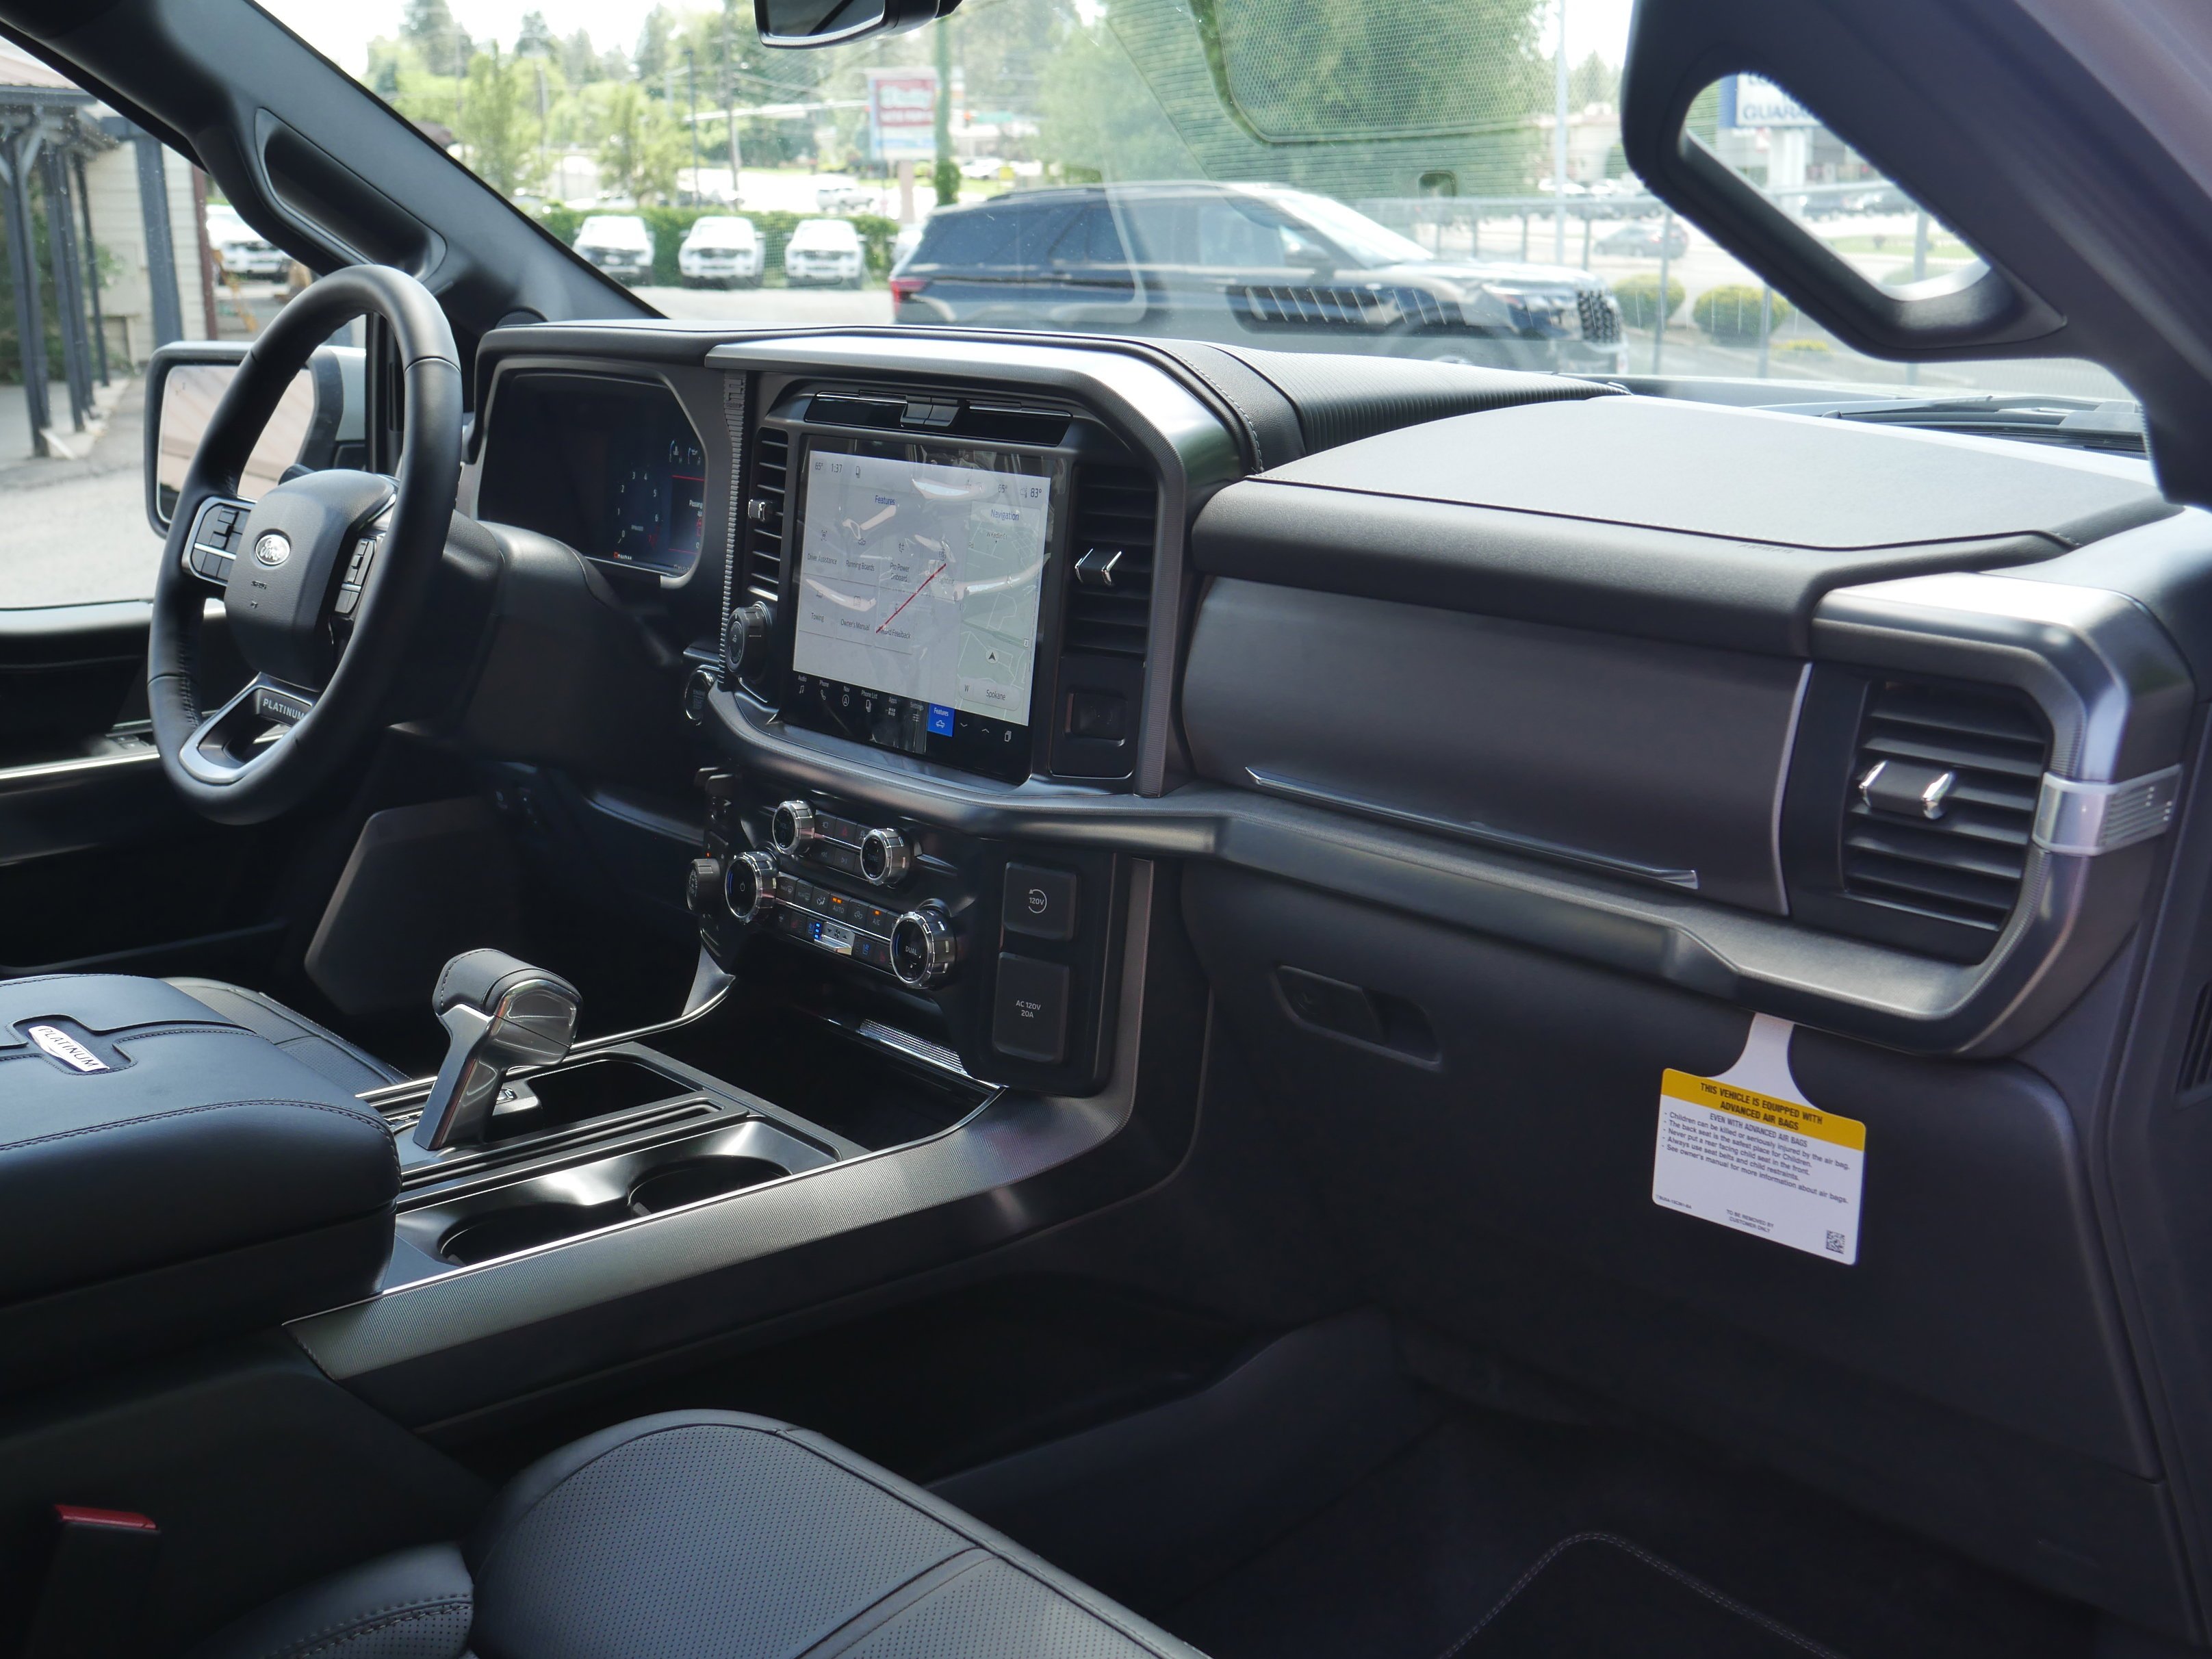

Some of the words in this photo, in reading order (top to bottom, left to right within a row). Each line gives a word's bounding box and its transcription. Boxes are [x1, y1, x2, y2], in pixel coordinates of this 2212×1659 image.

[831, 463, 843, 473] 1:37
[1030, 488, 1042, 498] 83°
[875, 495, 895, 505] Features
[991, 509, 1019, 520] Navigation
[819, 555, 837, 564] Assistance
[846, 560, 861, 570] Running
[862, 563, 875, 571] Boards
[898, 564, 910, 572] Power
[811, 613, 824, 623] Towing
[841, 619, 856, 628] Owner's
[856, 621, 870, 630] Manual
[819, 680, 830, 688] Phone
[861, 690, 871, 698] Phone
[986, 689, 1006, 701] Spokane
[263, 698, 305, 720] PLATINUM
[934, 707, 949, 717] Features
[1029, 897, 1044, 906] 120V
[905, 945, 917, 955] DUAL
[1016, 1000, 1025, 1008] AC
[1026, 1002, 1042, 1011] 120V
[1020, 1009, 1034, 1018] 20A
[38, 1028, 99, 1067] PLATINUM
[1700, 1082, 1717, 1094] THIS
[1719, 1088, 1750, 1104] VEHICLE
[1751, 1096, 1760, 1107] IS
[1762, 1099, 1799, 1118] EQUIPPED
[1802, 1111, 1823, 1124] WITH
[1719, 1101, 1760, 1119] ADVANCED
[1762, 1113, 1775, 1123] AIR
[1777, 1116, 1799, 1130] BAGS
[1709, 1112, 1725, 1124] EVEN
[1727, 1118, 1742, 1129] WITH
[1744, 1122, 1777, 1138] ADVANCED
[1777, 1133, 1789, 1142] AIR
[1790, 1136, 1807, 1147] BAGS
[1669, 1111, 1696, 1124] Children
[1719, 1126, 1736, 1136] killed
[1745, 1135, 1775, 1148] seriously
[1777, 1142, 1801, 1155] injured
[1811, 1153, 1823, 1162] the
[1834, 1159, 1849, 1171] bag.
[1669, 1119, 1680, 1128] The
[1681, 1123, 1697, 1133] back
[1697, 1129, 1712, 1137] seat
[1719, 1134, 1730, 1143] the
[1731, 1139, 1751, 1149] safest
[1751, 1145, 1770, 1155] place
[1771, 1149, 1781, 1158] for
[1782, 1153, 1812, 1168] Children.
[1667, 1128, 1686, 1138] Never
[1704, 1139, 1717, 1147] rear
[1718, 1142, 1738, 1155] facing
[1739, 1150, 1756, 1159] child
[1756, 1155, 1771, 1163] seat
[1779, 1161, 1790, 1170] the
[1792, 1164, 1810, 1176] front.
[1667, 1136, 1690, 1148] Always
[1703, 1147, 1717, 1156] seat
[1718, 1150, 1734, 1161] belts
[1735, 1157, 1748, 1165] and
[1749, 1161, 1766, 1170] child
[1766, 1166, 1799, 1181] restraints.
[1666, 1144, 1678, 1153] See
[1679, 1148, 1704, 1160] owner's
[1705, 1156, 1729, 1168] manual
[1729, 1162, 1739, 1170] for
[1740, 1167, 1758, 1176] more
[1758, 1171, 1797, 1188] information
[1797, 1184, 1817, 1195] about
[1828, 1192, 1848, 1204] bags.
[1729, 1216, 1757, 1229] CUSTOMER
[1742, 1214, 1766, 1226] REMOVED
